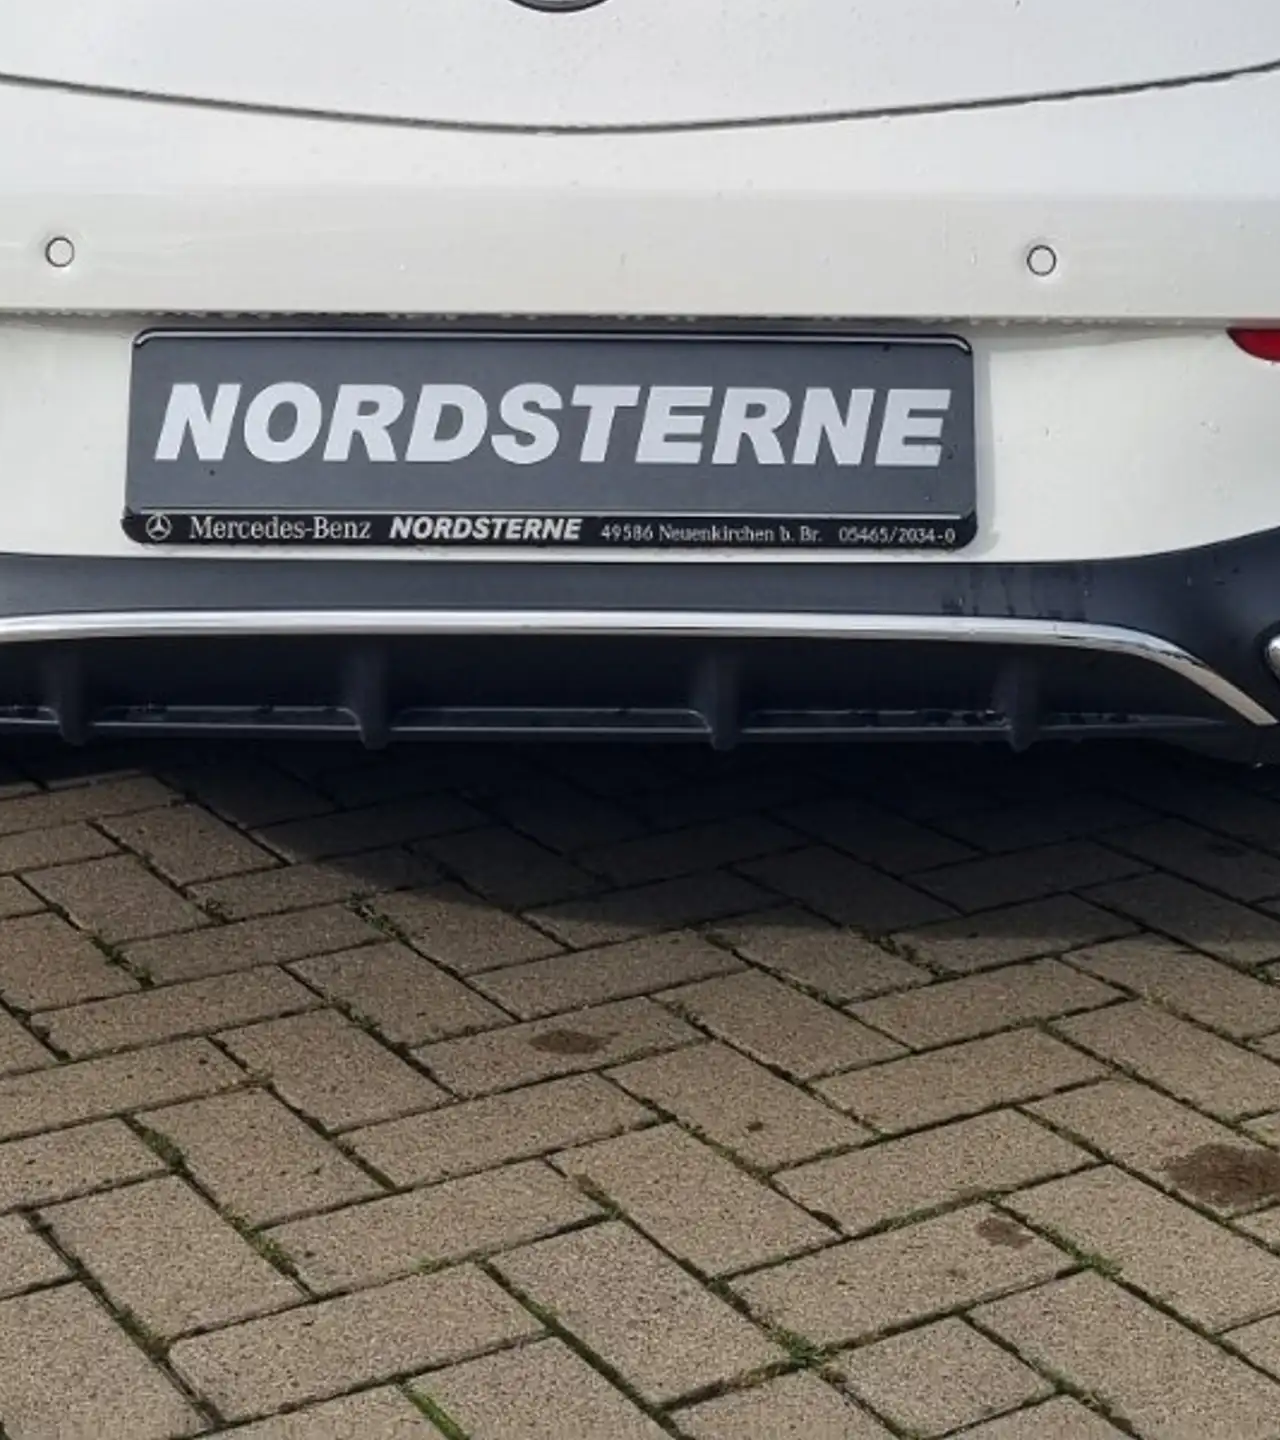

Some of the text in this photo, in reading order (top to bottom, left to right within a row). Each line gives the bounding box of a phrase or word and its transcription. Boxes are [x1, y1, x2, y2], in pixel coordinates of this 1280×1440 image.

[155, 381, 953, 468] NORDSTERNE
[189, 515, 371, 541] Mercedes-Benz
[388, 516, 583, 541] NORDSTERNE
[600, 524, 654, 542] 49586
[658, 524, 776, 544] Neuenkirchen
[779, 525, 795, 544] b.
[800, 526, 822, 544] Br.
